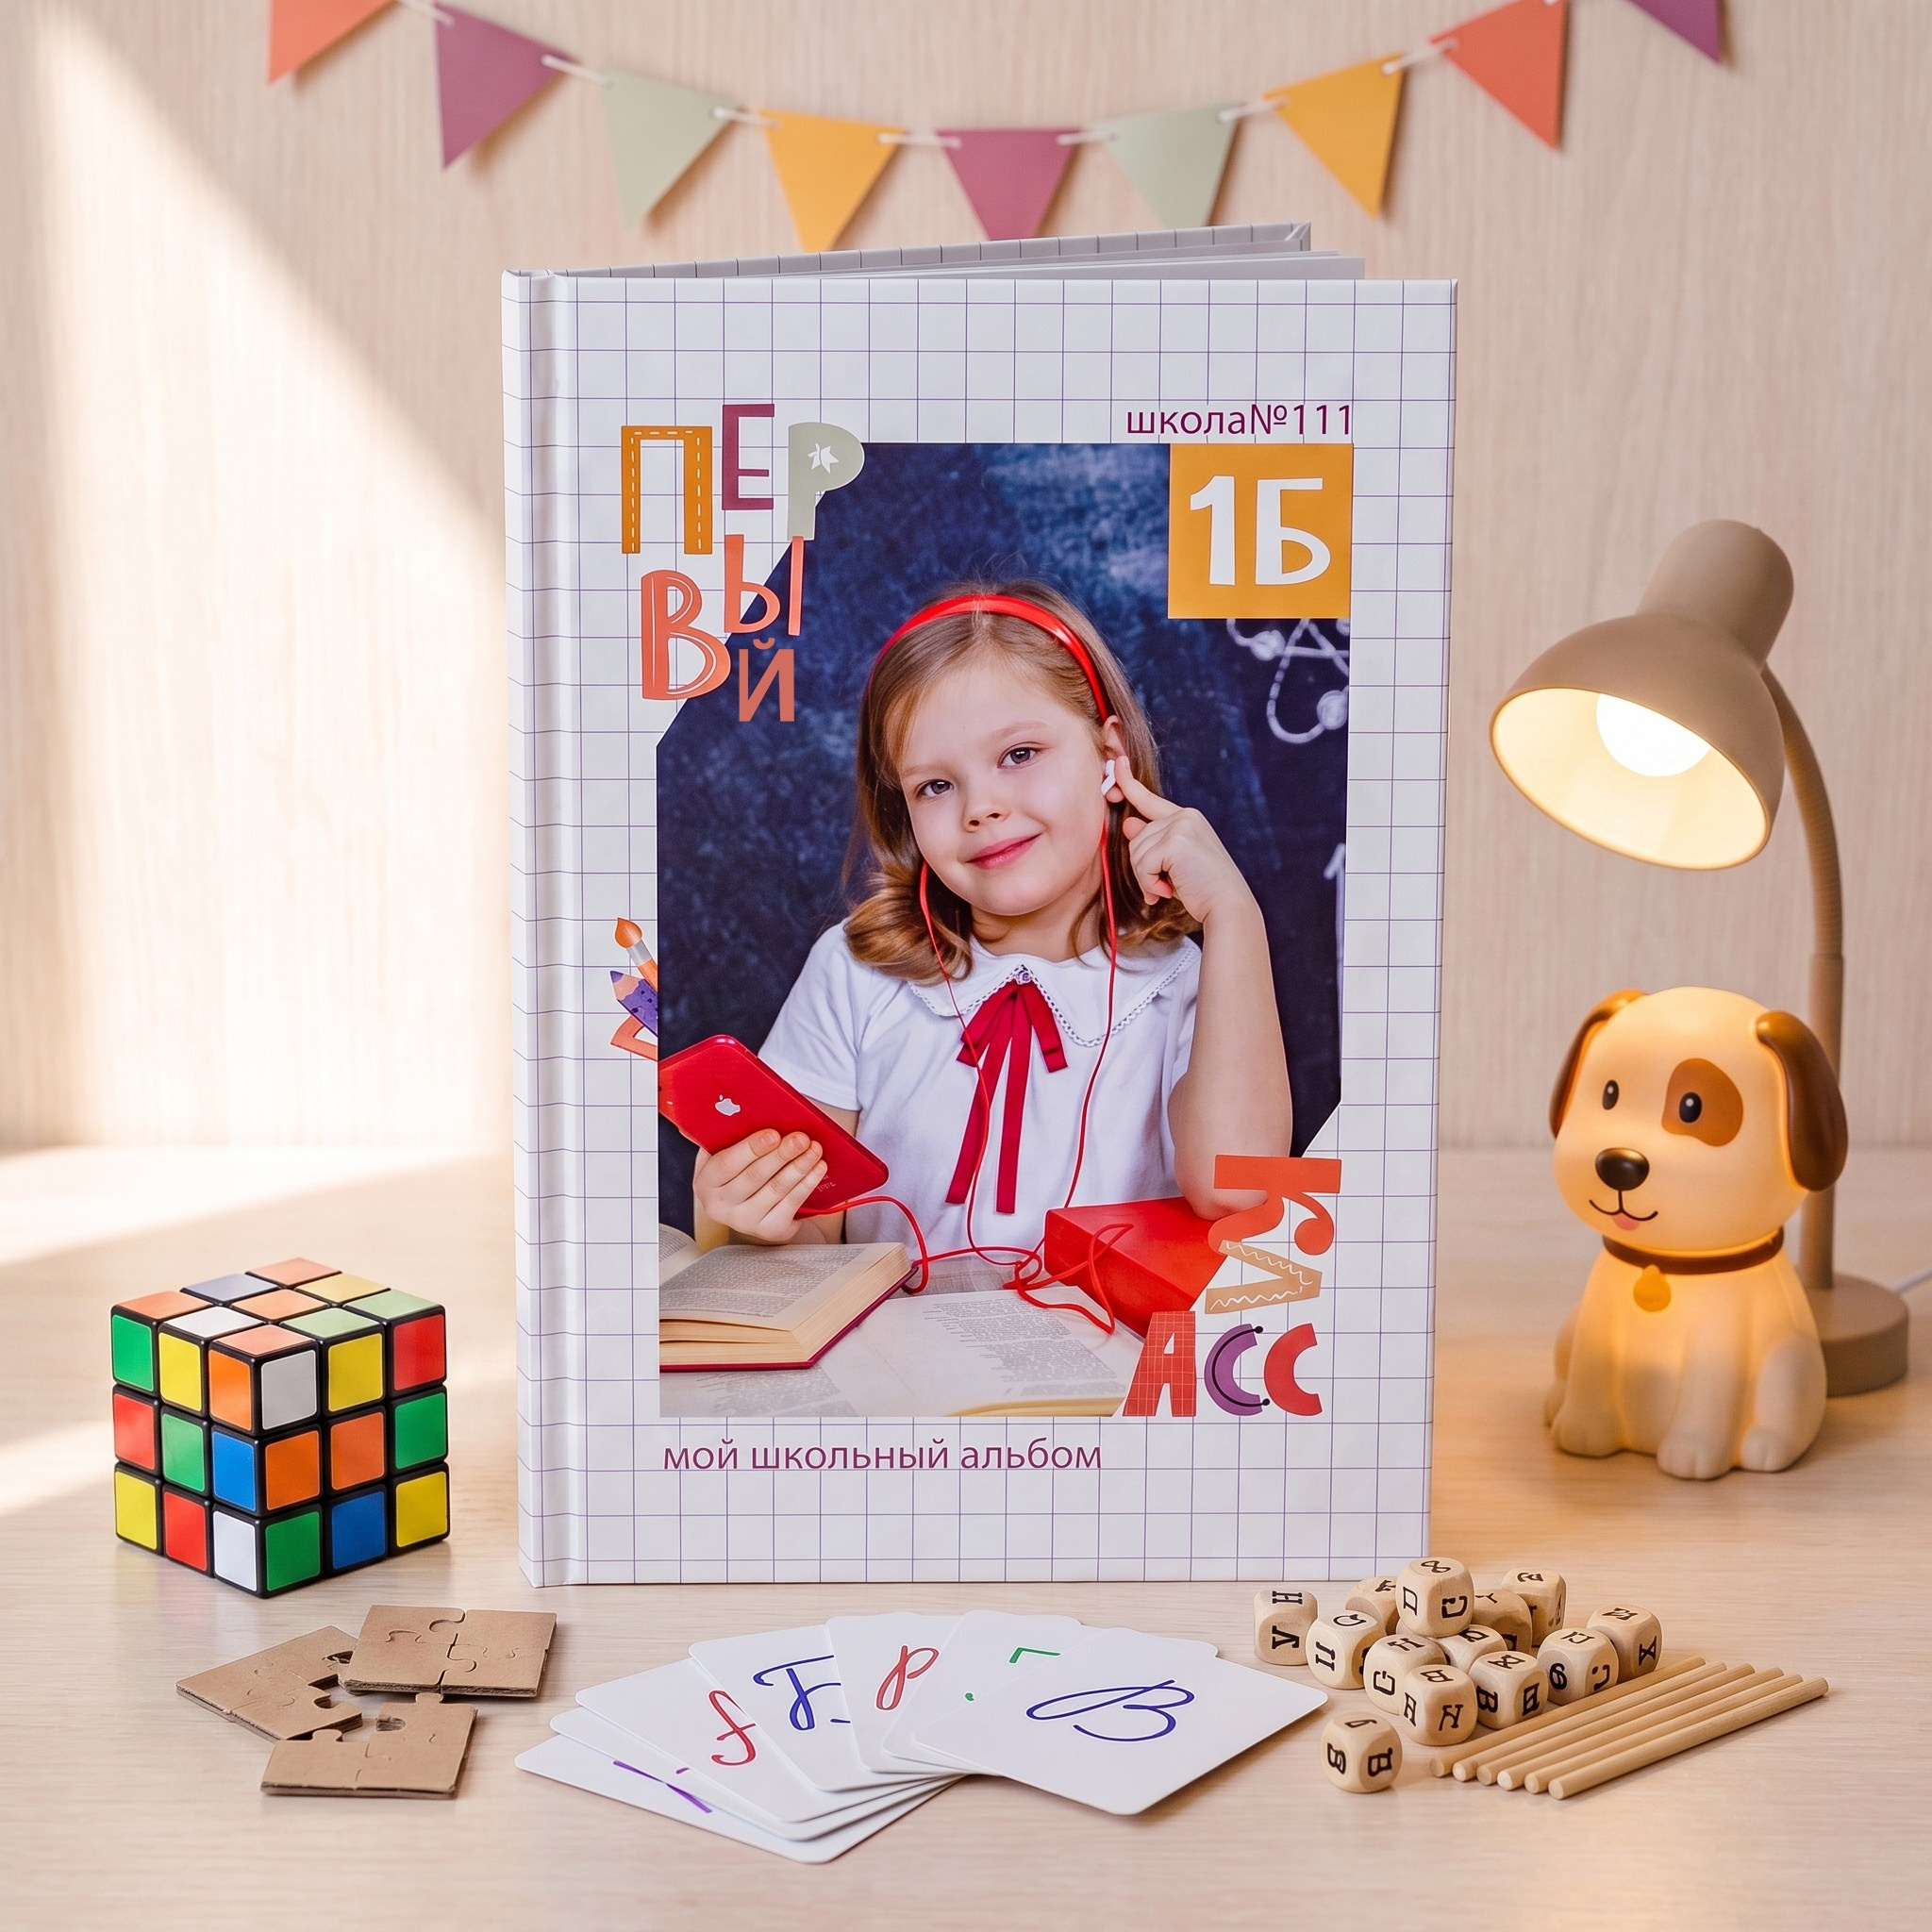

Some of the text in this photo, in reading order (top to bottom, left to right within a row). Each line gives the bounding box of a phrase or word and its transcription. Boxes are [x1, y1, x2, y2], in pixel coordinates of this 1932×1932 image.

[1126, 403, 1351, 436] школа№111
[1190, 475, 1331, 586] 1Б
[663, 1437, 1102, 1471] мой школьный альбом
